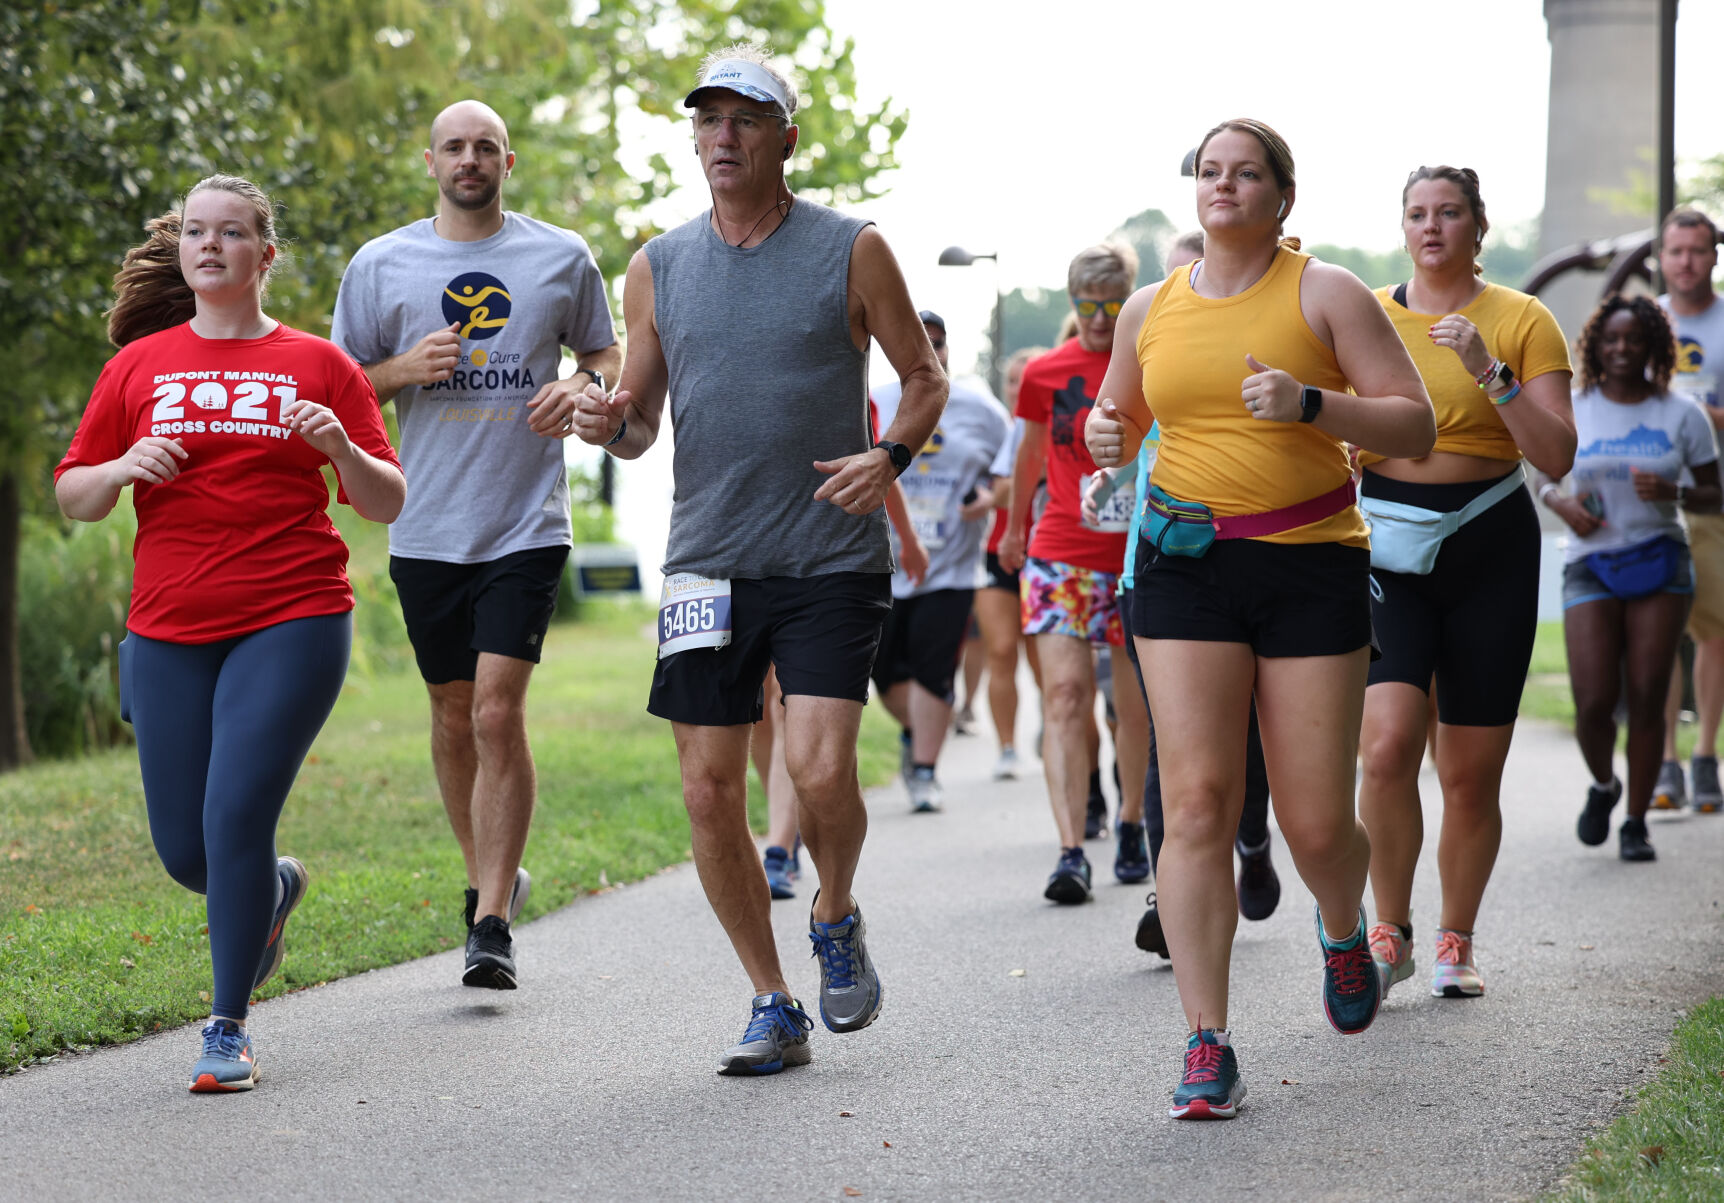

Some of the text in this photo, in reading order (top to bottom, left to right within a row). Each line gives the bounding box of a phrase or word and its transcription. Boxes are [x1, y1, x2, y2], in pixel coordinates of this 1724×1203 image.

[489, 351, 520, 364] Cure
[153, 371, 298, 386] DUPONT MANUAL
[152, 381, 297, 425] 2021
[438, 406, 518, 422] LOUISVILLE
[151, 420, 292, 440] CROSS COUNTRY
[673, 580, 715, 593] SARCOMA
[664, 598, 715, 639] 5465
